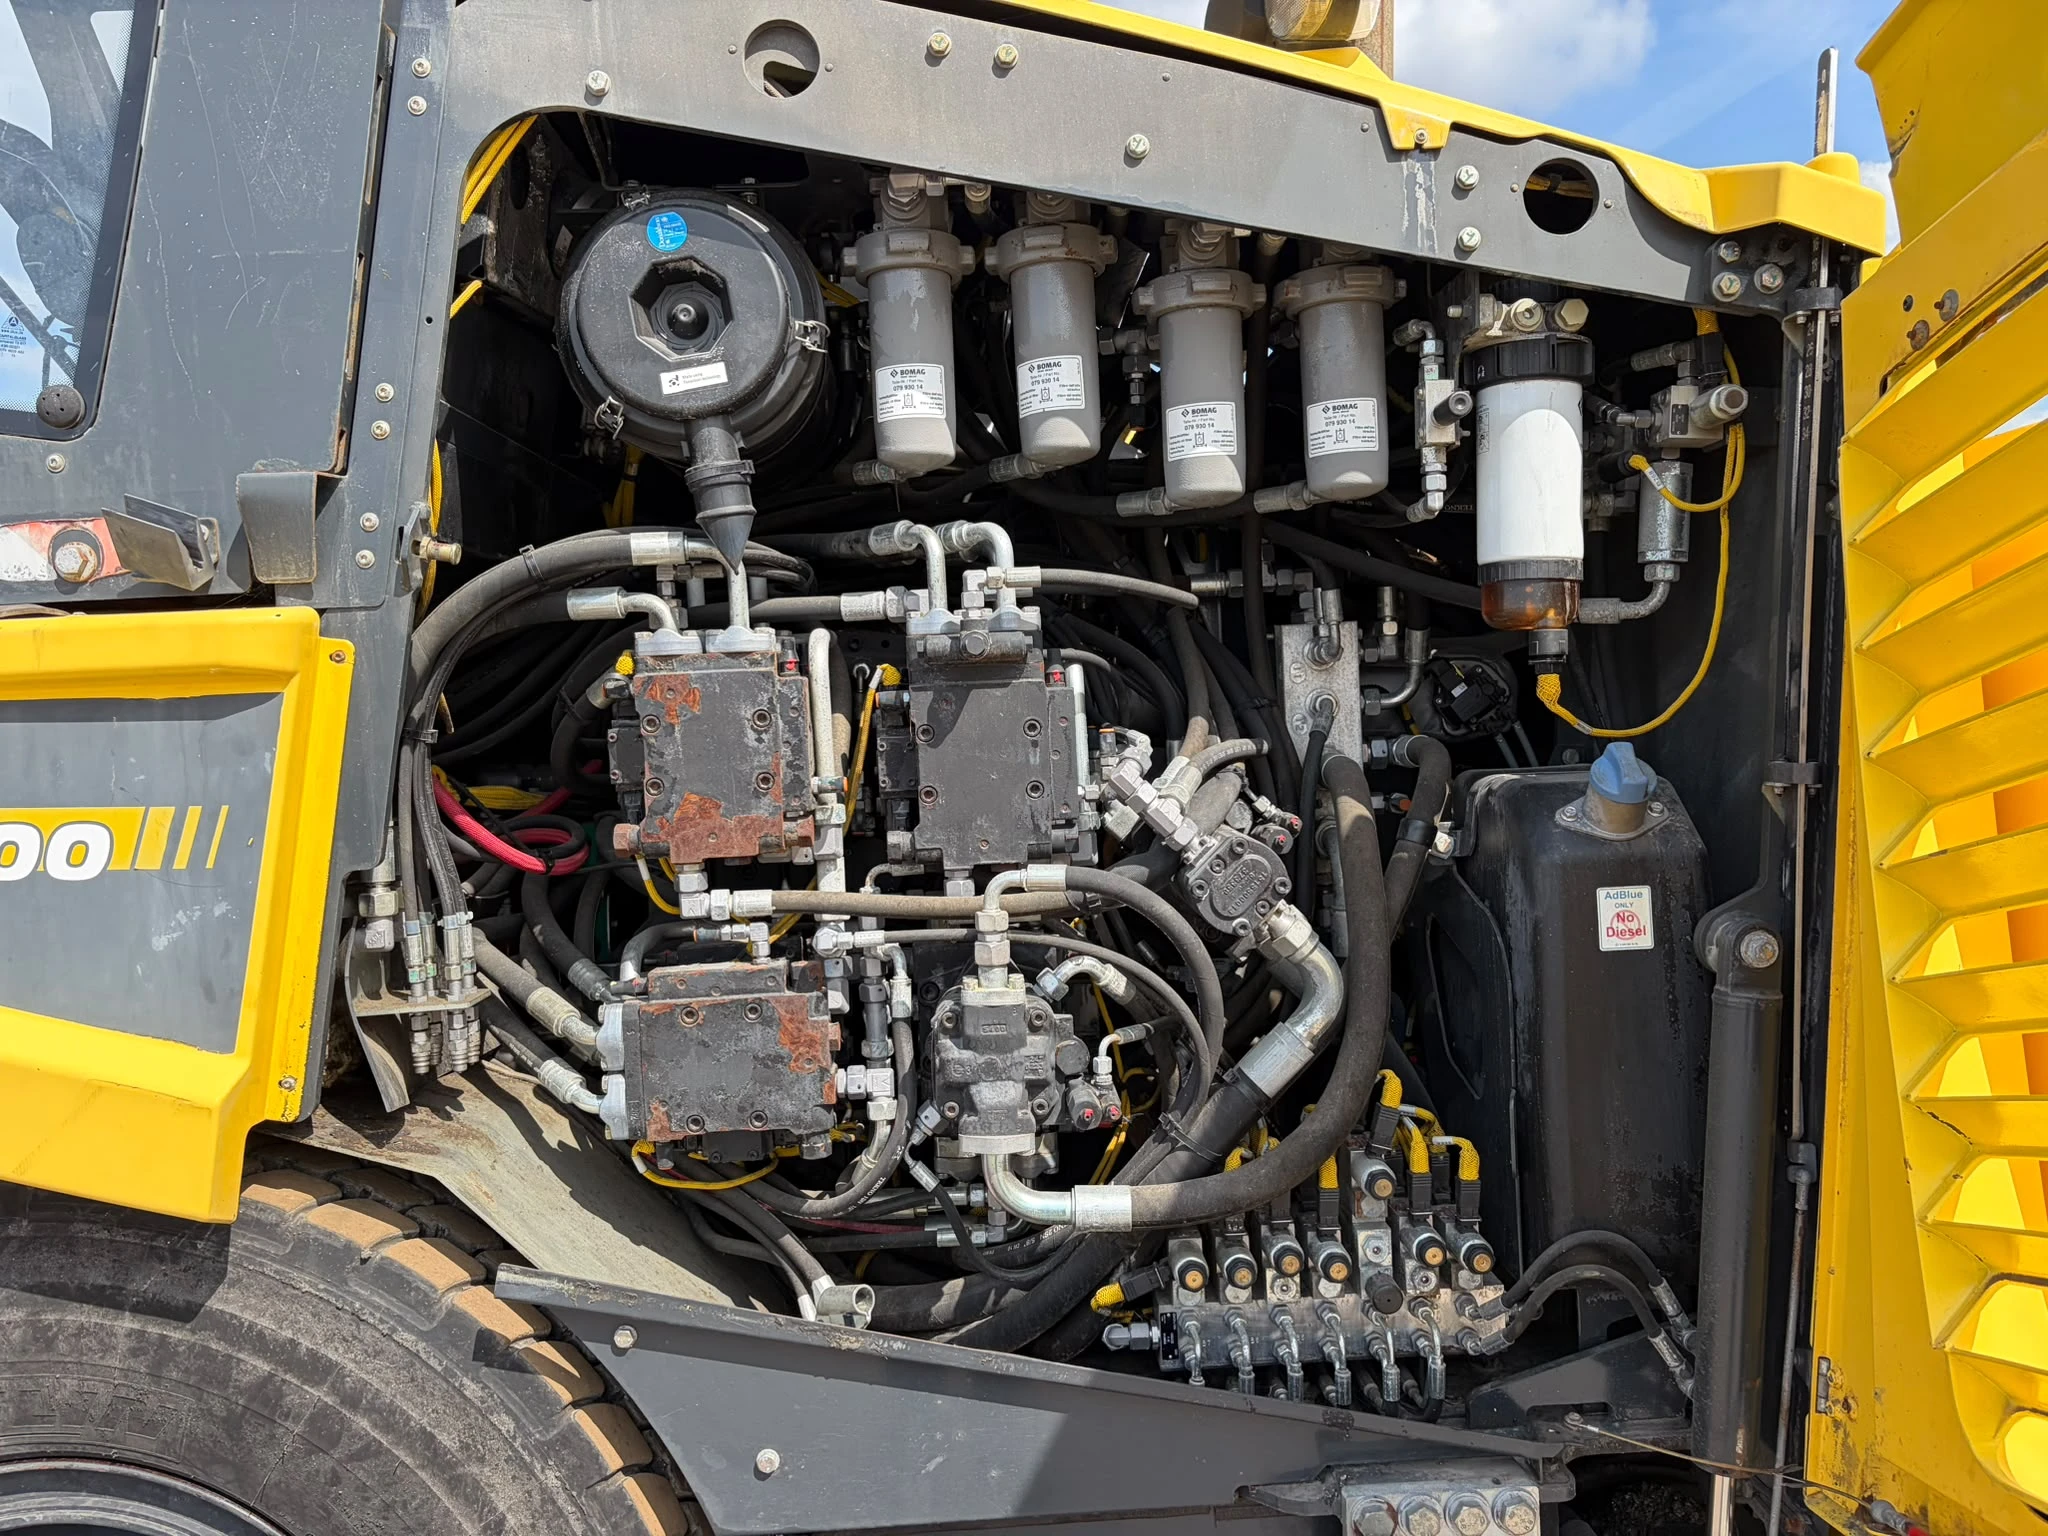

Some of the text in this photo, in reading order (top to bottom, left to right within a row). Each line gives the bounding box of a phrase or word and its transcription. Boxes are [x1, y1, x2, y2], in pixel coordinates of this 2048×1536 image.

[1036, 361, 1062, 371] BOMAG
[1191, 407, 1217, 415] BOMAG
[1332, 403, 1359, 412] BOMAG
[1604, 890, 1643, 900] AdBlue
[1616, 911, 1635, 923] No
[1606, 925, 1647, 938] Diesel
[867, 1176, 887, 1197] TEKNO
